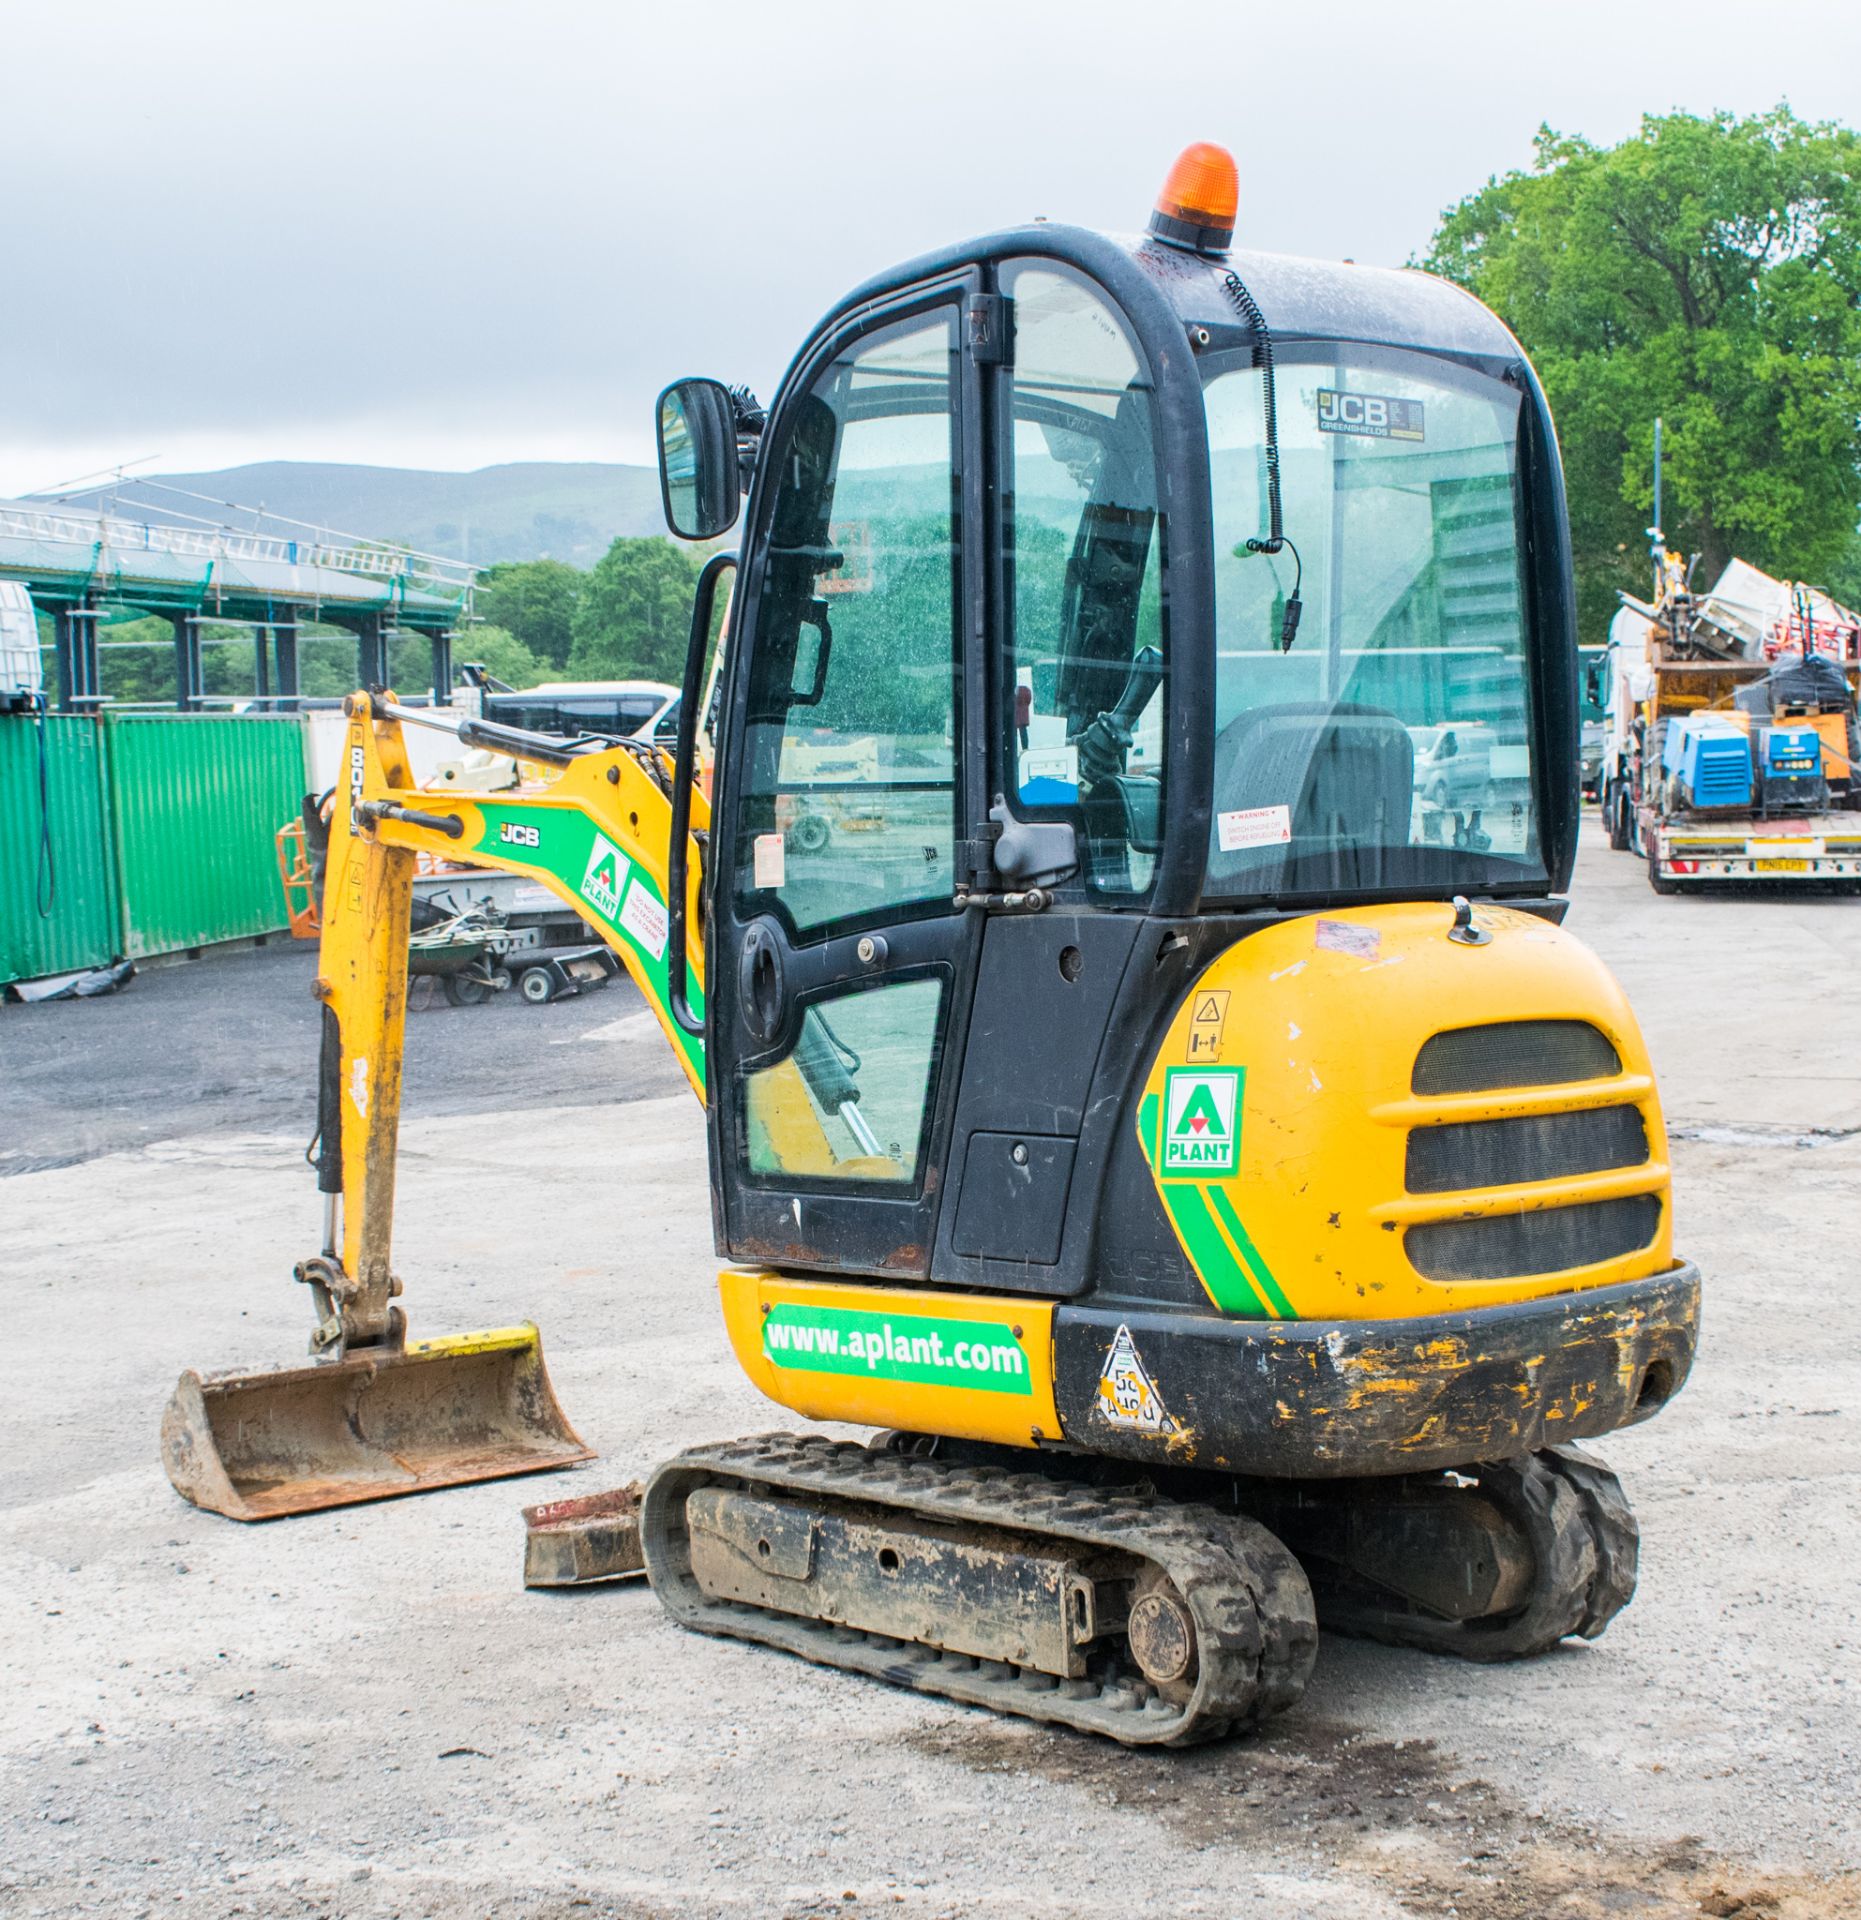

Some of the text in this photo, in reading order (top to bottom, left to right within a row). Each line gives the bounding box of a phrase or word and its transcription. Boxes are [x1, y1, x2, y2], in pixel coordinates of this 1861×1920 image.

[1320, 393, 1388, 427] JCB
[1320, 420, 1388, 437] GREENSHIELDS
[1238, 811, 1270, 819] WARNING
[501, 823, 539, 847] JCB
[591, 852, 616, 897] A
[583, 878, 617, 915] PLANT
[1175, 1084, 1226, 1135] A
[1168, 1143, 1230, 1161] PLANT
[766, 1323, 1023, 1374] www.aplant.com
